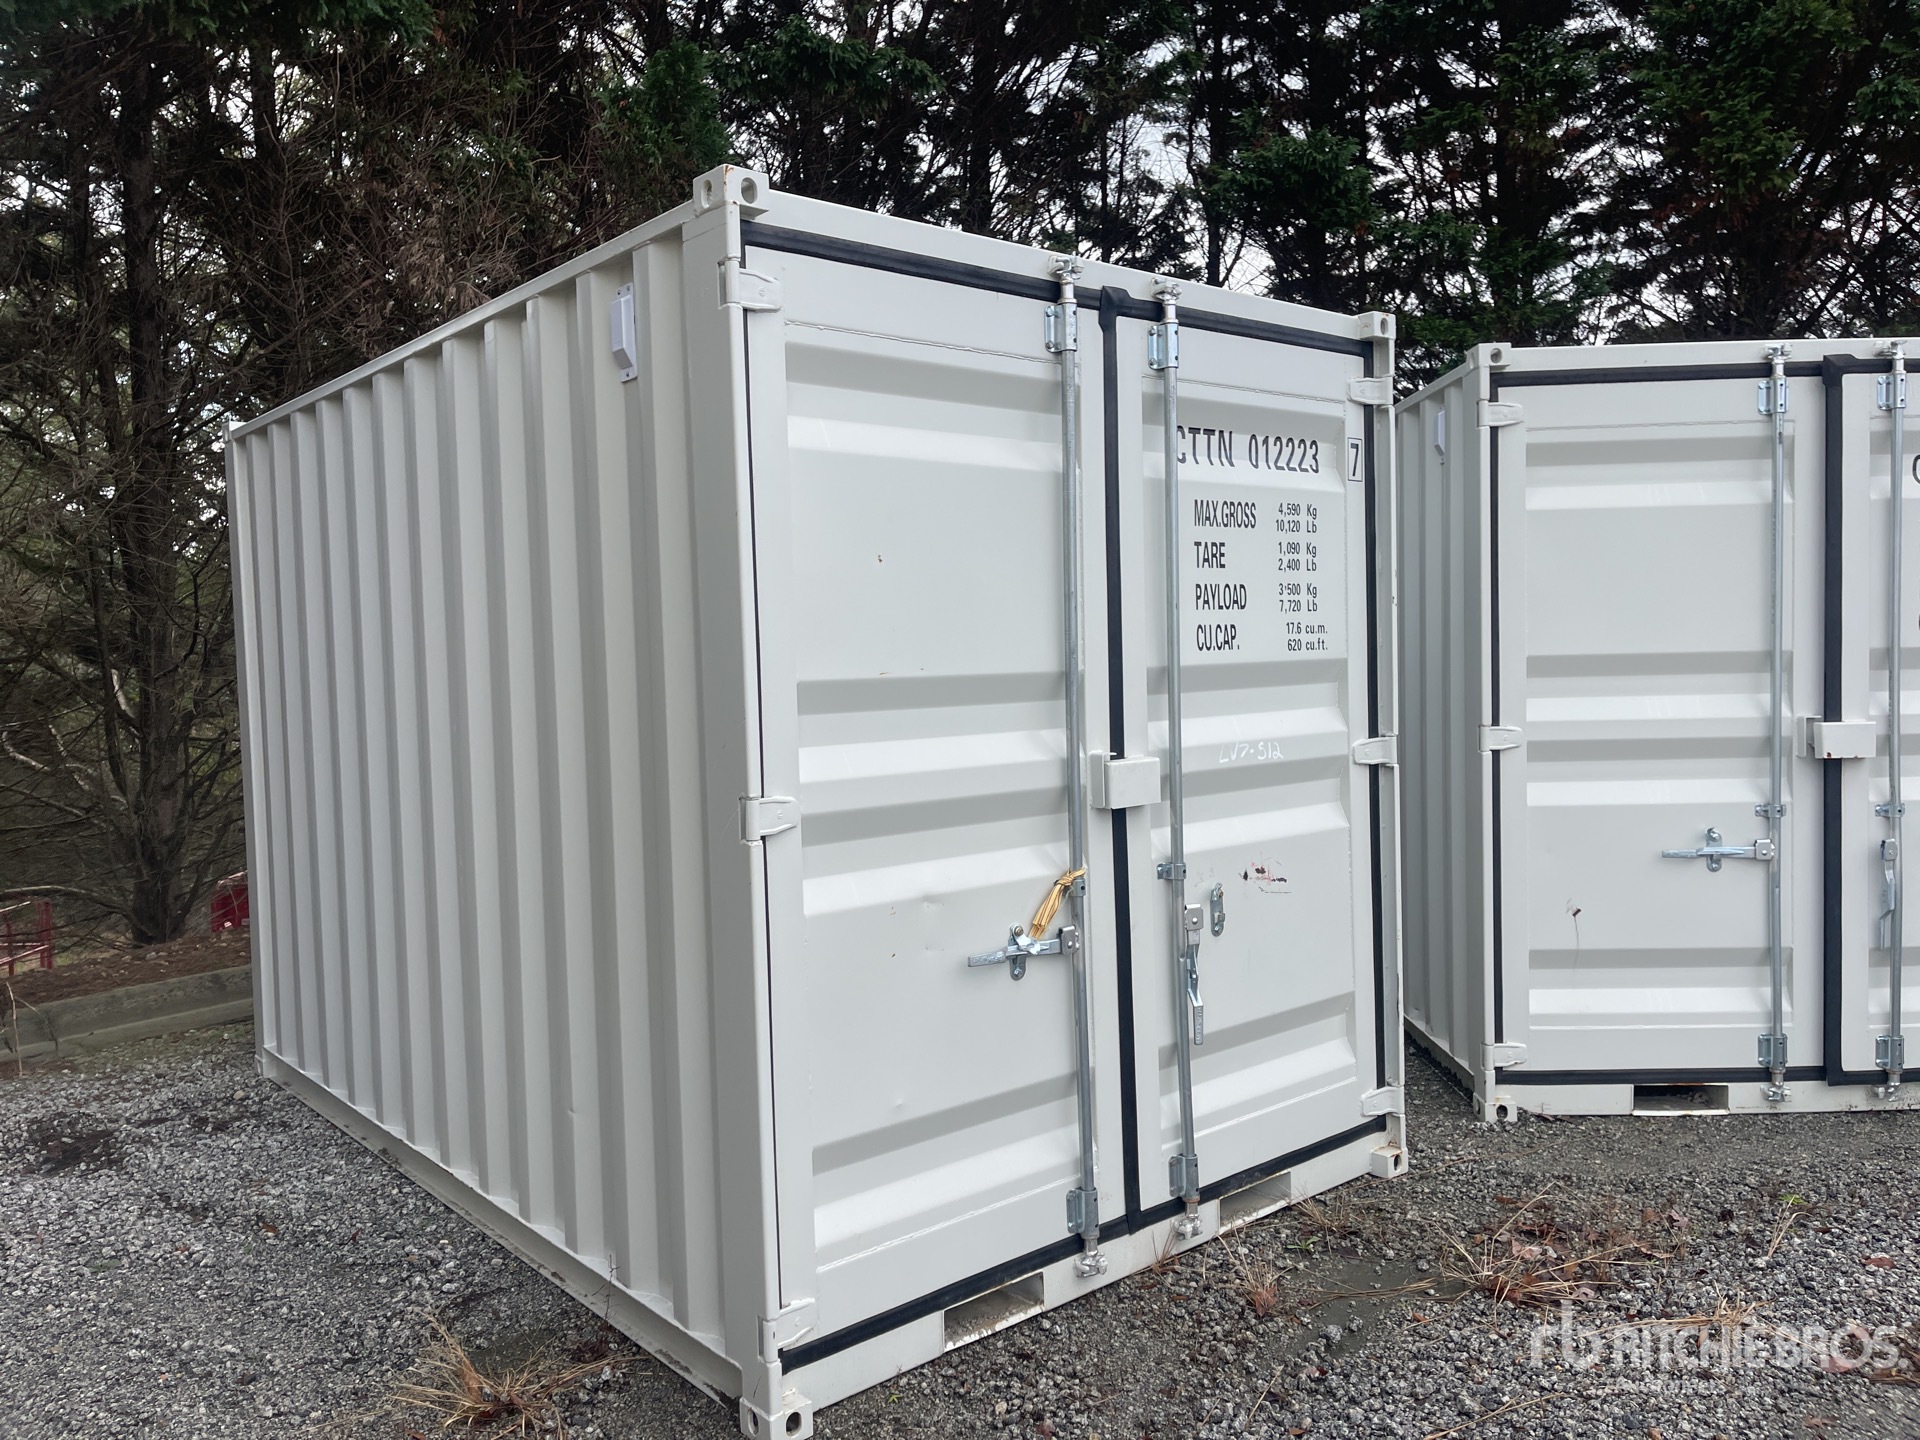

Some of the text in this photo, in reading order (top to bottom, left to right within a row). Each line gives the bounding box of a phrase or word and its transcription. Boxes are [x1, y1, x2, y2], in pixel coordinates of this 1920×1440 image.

[1177, 425, 1235, 467] CTTN
[1248, 434, 1320, 473] 012223
[1194, 499, 1318, 529] MAX.GROSS 4,590 Kg
[1275, 519, 1318, 534] 10,120 Lb
[1194, 541, 1317, 569] TARE 1,090 Kg
[1278, 558, 1317, 573] 2,400 Lb
[1195, 583, 1247, 611] PAYLOAD
[1306, 583, 1318, 599] Kg
[1279, 600, 1318, 614] 7,720 Lb
[1196, 622, 1328, 651] CU.CAP. 17.6 cu.m.
[1287, 637, 1328, 652] 620 cu.ft.
